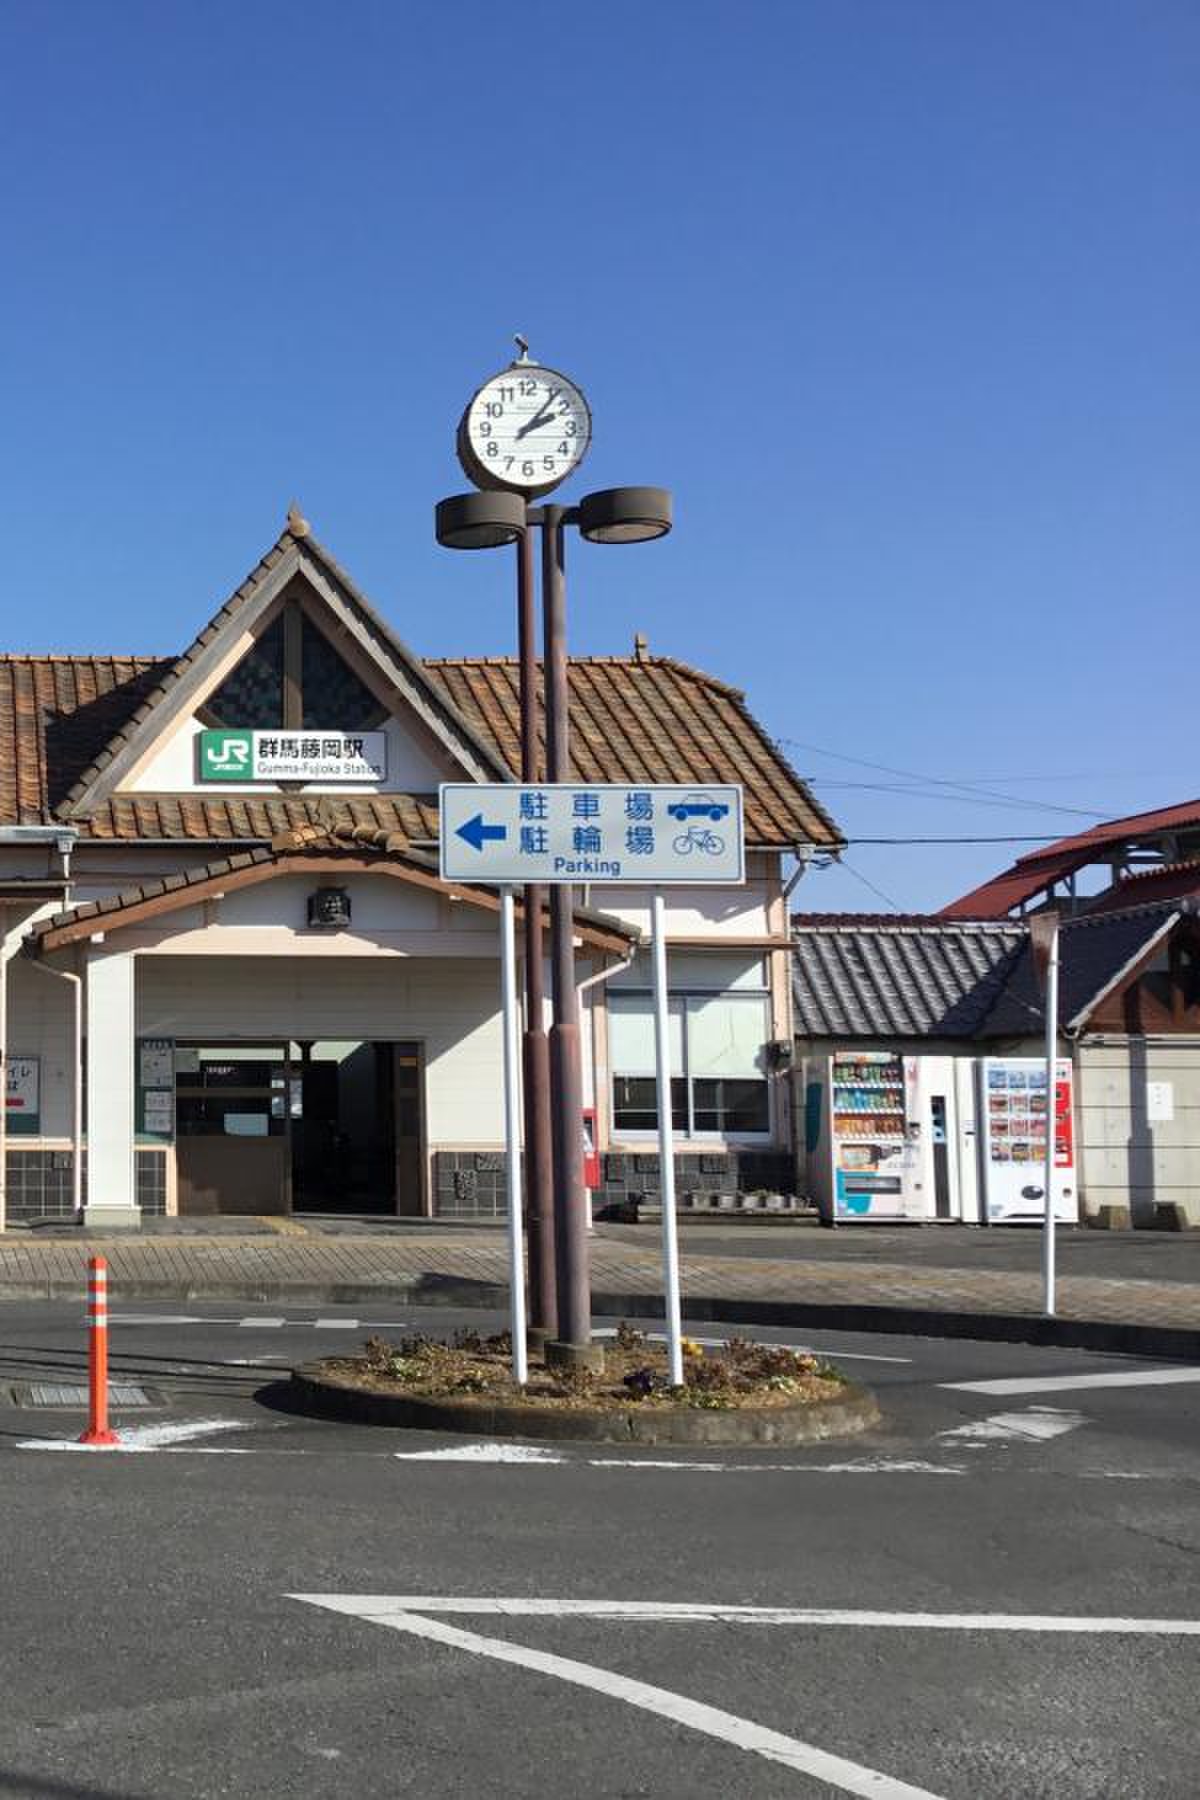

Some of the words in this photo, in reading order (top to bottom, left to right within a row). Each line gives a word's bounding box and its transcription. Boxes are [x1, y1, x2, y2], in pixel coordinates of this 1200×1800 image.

[498, 387, 514, 402] 11
[518, 380, 537, 396] 12
[484, 402, 503, 418] 10
[558, 401, 570, 416] 2
[480, 422, 491, 438] 9
[565, 422, 577, 437] 3
[486, 441, 498, 457] 8
[557, 441, 568, 456] 4
[503, 455, 515, 471] 7
[522, 461, 534, 477] 6
[543, 455, 554, 471] 5
[207, 739, 249, 763] JR
[258, 737, 364, 759] 群馬藤岡駅
[343, 761, 382, 774] Station
[519, 792, 654, 821] 駐車場
[519, 826, 655, 855] 駐輪場
[554, 857, 621, 876] Parking
